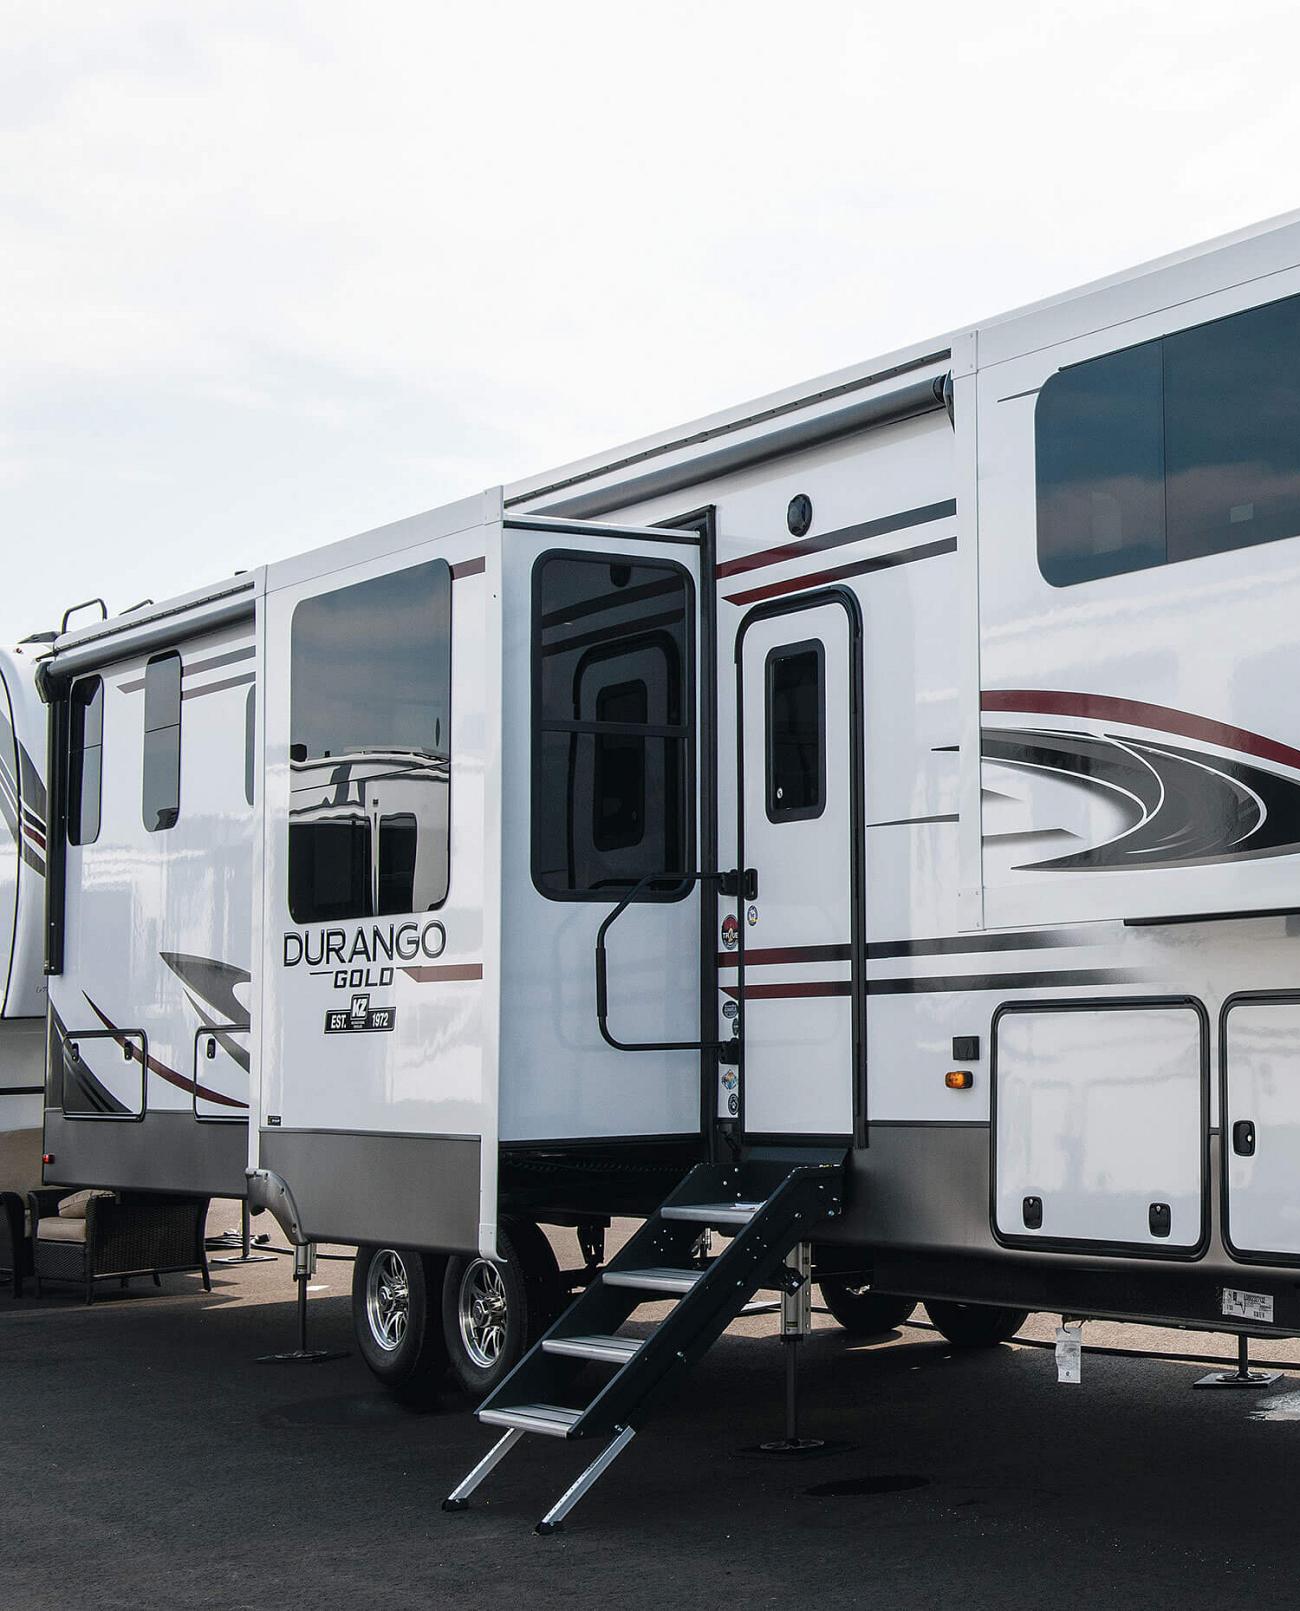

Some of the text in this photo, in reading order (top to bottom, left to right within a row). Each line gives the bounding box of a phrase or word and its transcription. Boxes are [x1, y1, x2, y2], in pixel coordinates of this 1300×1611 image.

[283, 919, 447, 967] DURANGO
[333, 967, 394, 989] GOLD
[352, 998, 368, 1018] KZ
[331, 1015, 347, 1029] EST.
[372, 1012, 389, 1027] 1972
